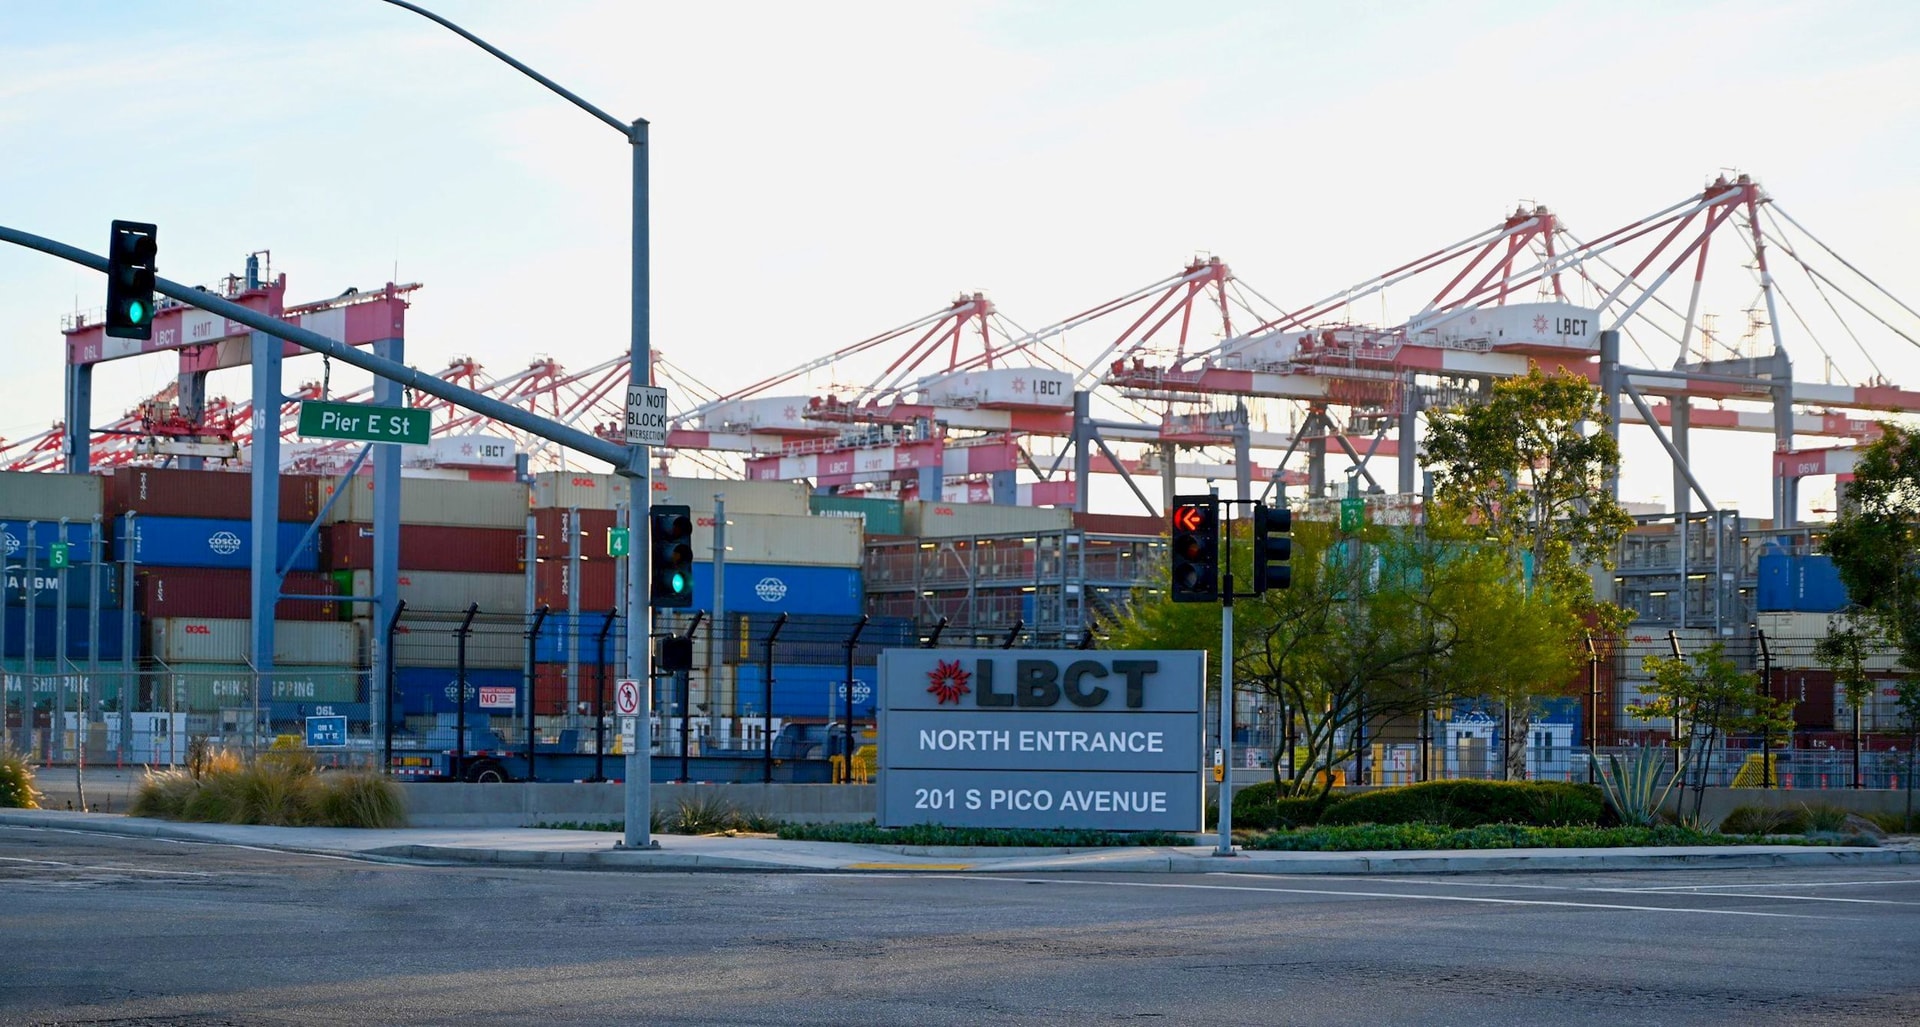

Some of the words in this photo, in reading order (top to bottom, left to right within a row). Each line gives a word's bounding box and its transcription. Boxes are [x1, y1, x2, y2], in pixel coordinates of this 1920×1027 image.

[192, 321, 212, 338] 41MT
[1556, 317, 1588, 336] LBCT
[155, 329, 175, 346] LBCT
[1033, 379, 1062, 395] LBCT
[628, 392, 642, 407] DO
[646, 394, 665, 408] NOT
[321, 411, 360, 432] Pier
[367, 415, 381, 434] E
[388, 416, 410, 436] St
[628, 412, 664, 428] BLOCK
[628, 429, 664, 440] INTERSECTION
[829, 461, 849, 474] LBCT
[1798, 463, 1819, 474] 06W
[613, 536, 622, 552] 4
[55, 551, 63, 564] 5
[755, 584, 787, 592] COSCO
[185, 625, 211, 634] OOCL
[976, 659, 1158, 708] LBCT
[481, 694, 497, 704] NO
[919, 729, 1010, 751] NORTH
[1019, 731, 1164, 753] ENTRANCE
[915, 789, 955, 809] 201
[965, 789, 982, 810] S
[990, 790, 1053, 811] PICO
[1060, 791, 1167, 813] AVENUE
